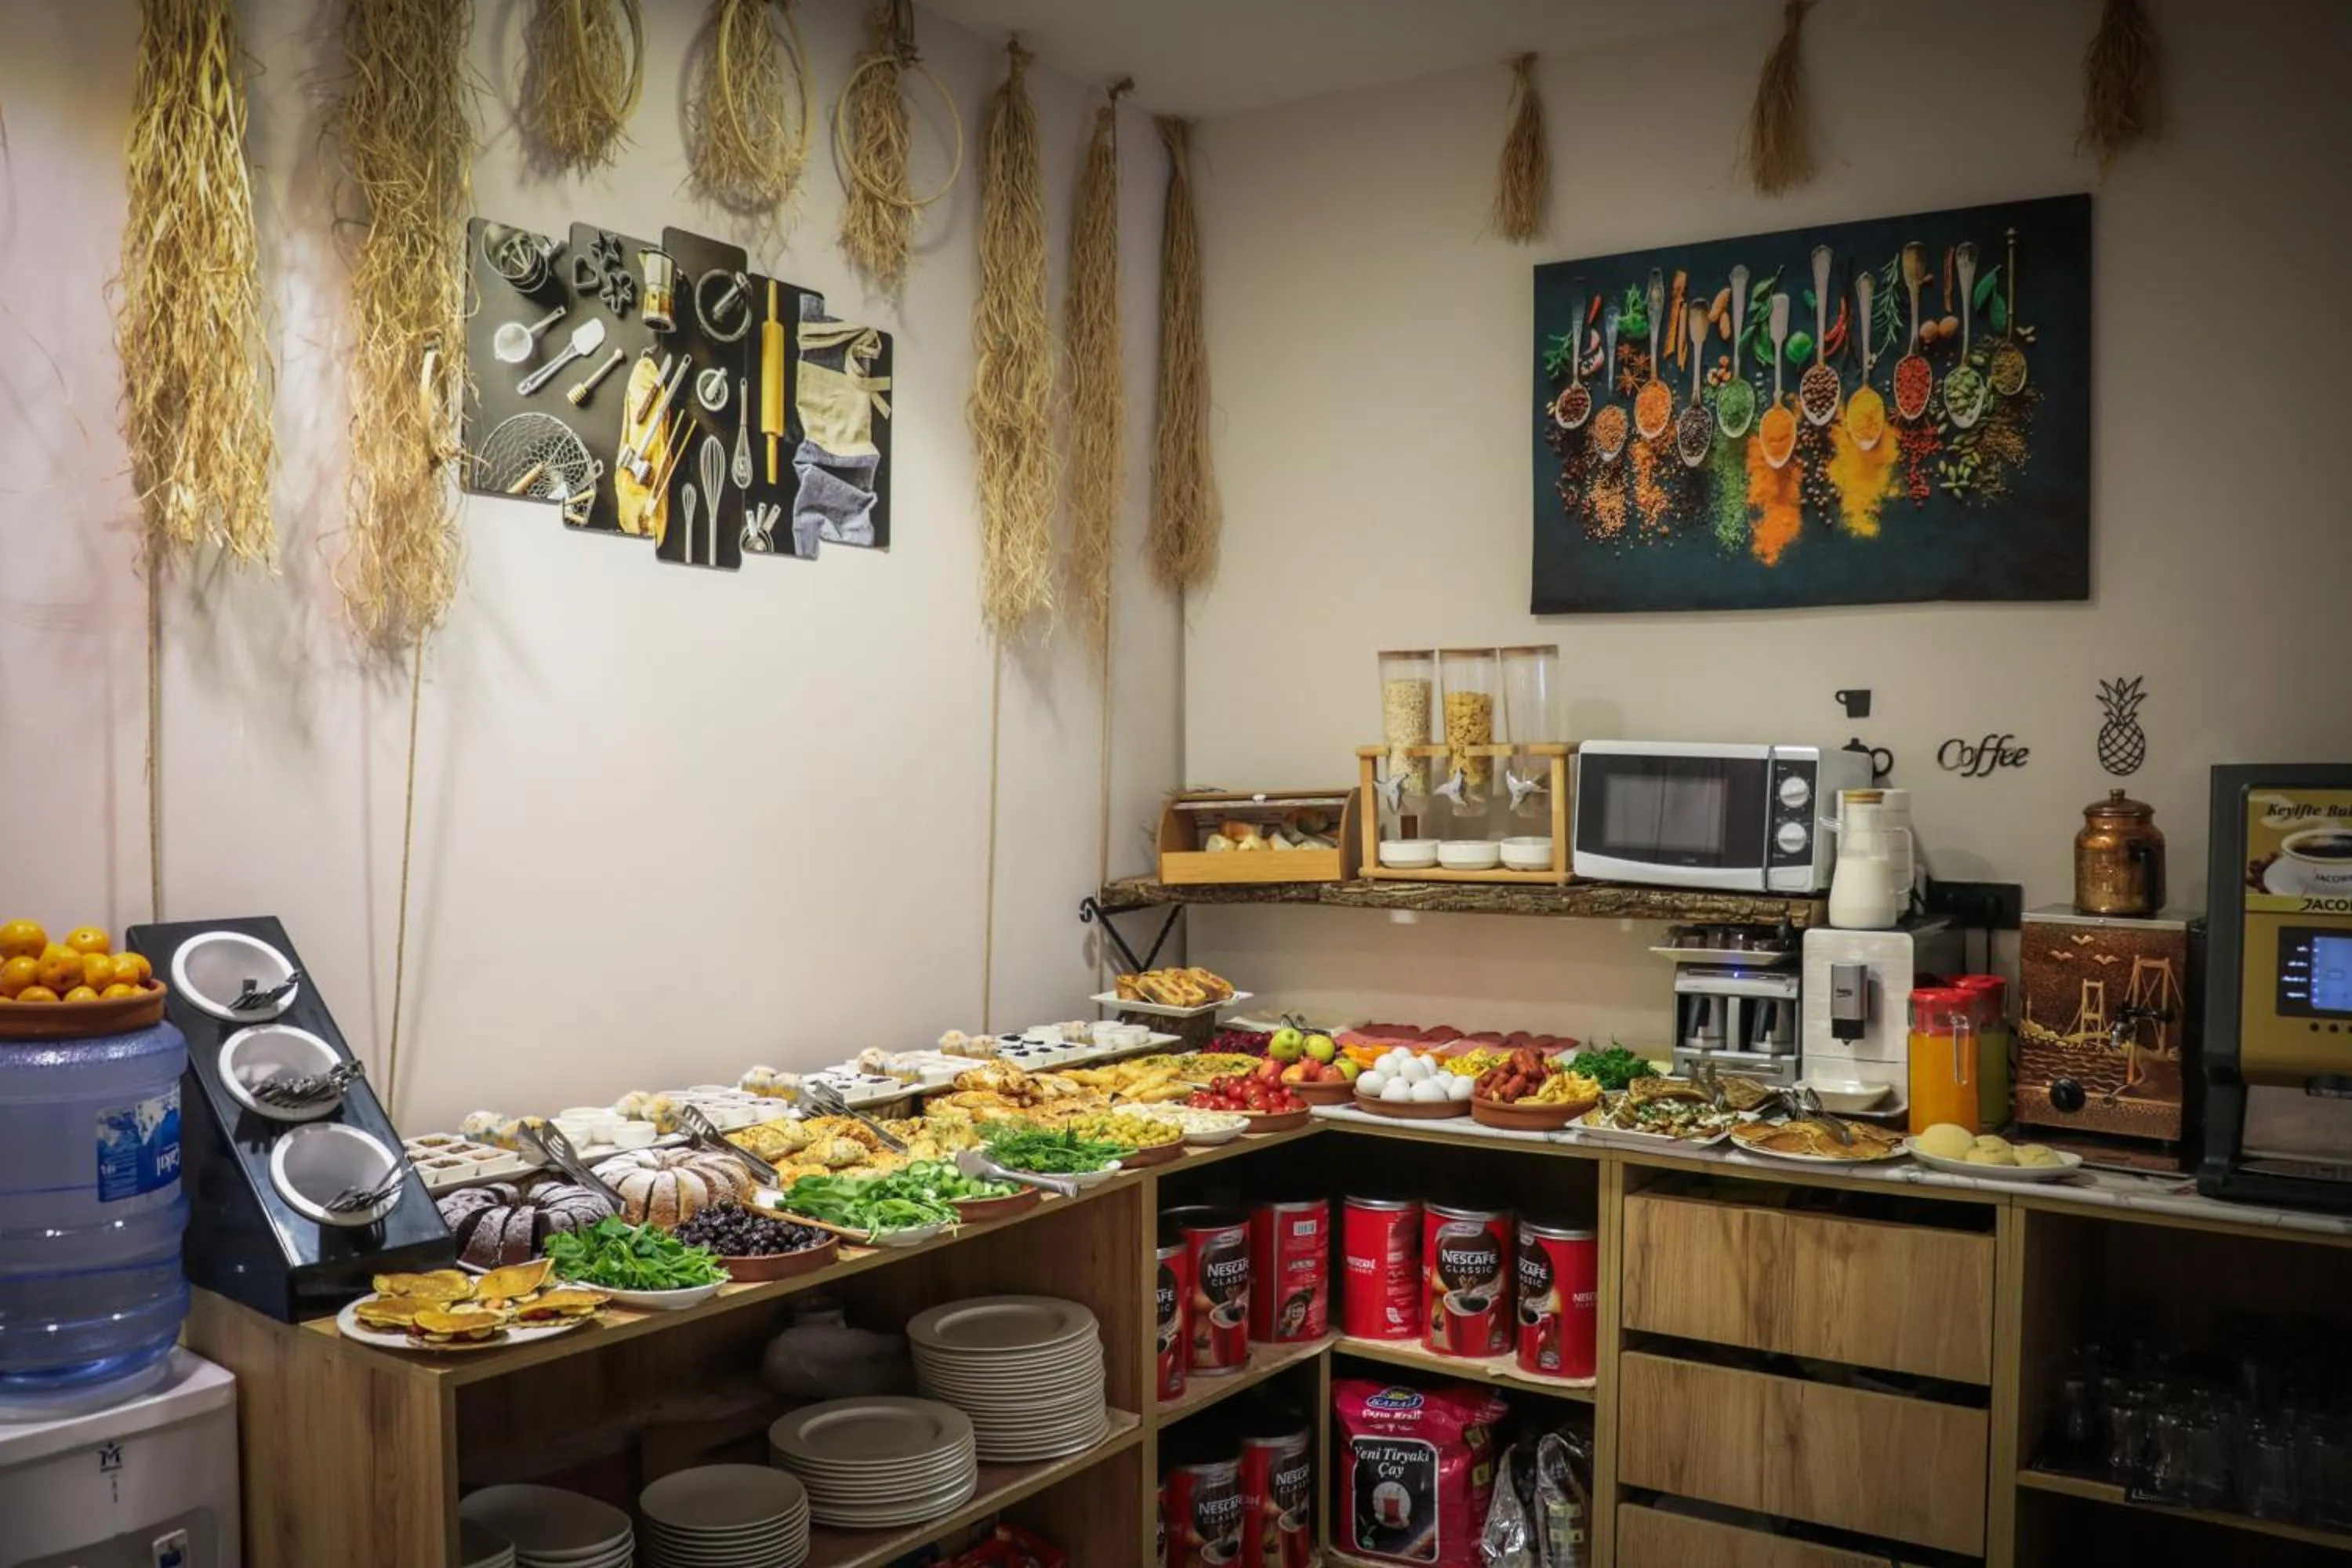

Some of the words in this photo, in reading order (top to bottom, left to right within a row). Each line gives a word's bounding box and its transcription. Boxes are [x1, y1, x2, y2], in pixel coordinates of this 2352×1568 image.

[1937, 733, 2030, 777] Coffee
[1445, 1264, 1493, 1274] CLASSIC
[1355, 1446, 1381, 1460] Yeni
[1385, 1448, 1429, 1465] Tiryaki
[1378, 1462, 1404, 1479] Çay
